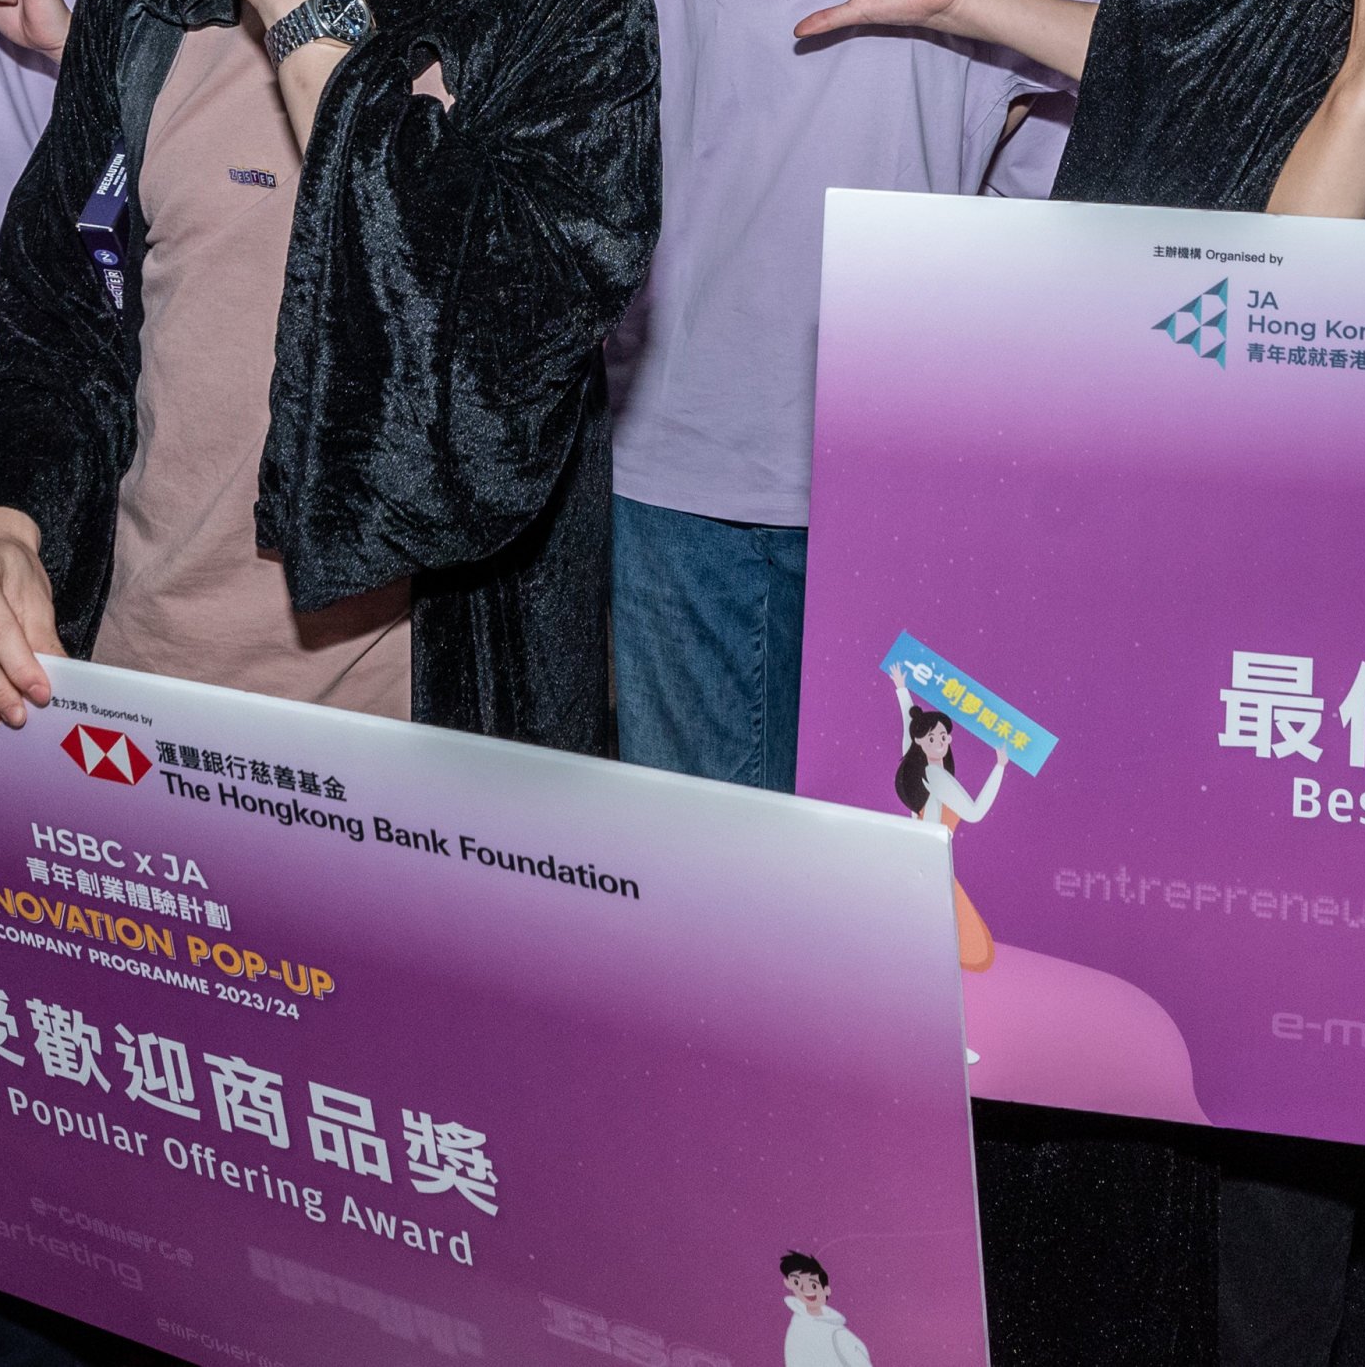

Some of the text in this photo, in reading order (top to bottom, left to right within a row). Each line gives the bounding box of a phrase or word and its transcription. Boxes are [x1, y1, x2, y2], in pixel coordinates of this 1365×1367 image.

[96, 153, 125, 195] PRECAUTION
[229, 168, 278, 188] ZESTER
[1153, 245, 1284, 266] 主辦機構 Organised by
[1247, 290, 1279, 310] JA
[1248, 314, 1316, 341] Hong
[51, 696, 153, 726] 全力支持 Supported by
[31, 823, 209, 890] HSBC x JA
[160, 769, 641, 900] The Hongkong Bank Foundation
[26, 856, 232, 932] 青年創業體驗計劃
[88, 947, 209, 996] PROGRAMME
[214, 982, 300, 1020] 2023/24
[187, 935, 335, 1000] POP-UP
[9, 1090, 147, 1157] Popular
[163, 1136, 326, 1223] Offering
[342, 1195, 473, 1266] Award
[30, 1197, 194, 1267] e-commerce
